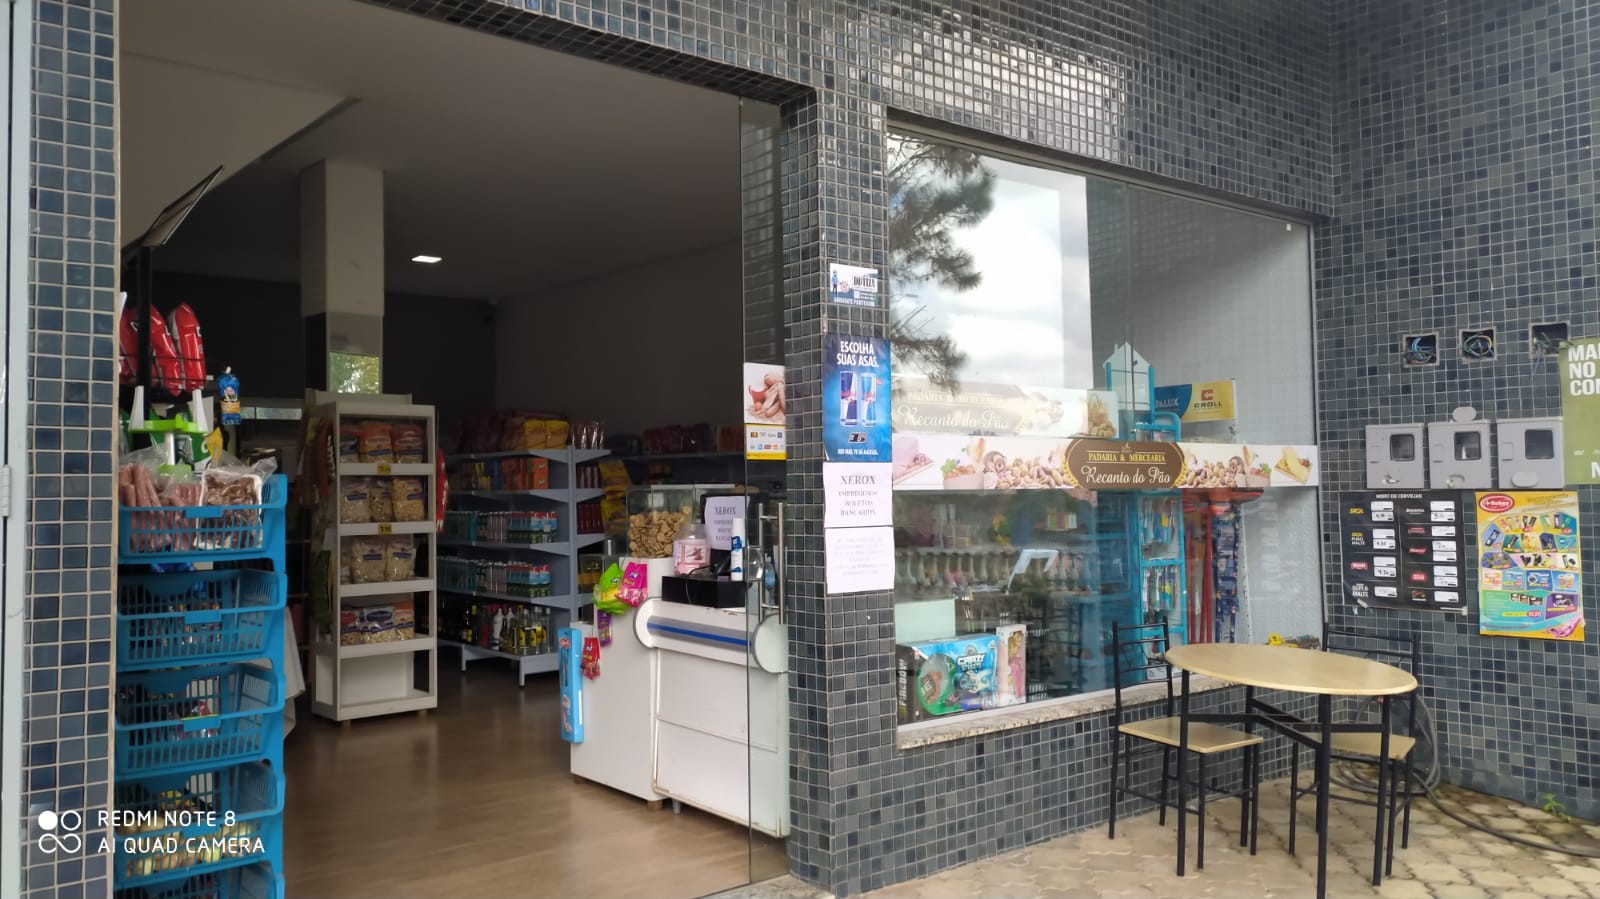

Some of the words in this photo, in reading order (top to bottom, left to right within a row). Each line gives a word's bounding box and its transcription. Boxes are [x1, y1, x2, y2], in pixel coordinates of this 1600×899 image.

[840, 341, 874, 355] ESCOLHA
[1568, 343, 1600, 361] MA
[836, 353, 857, 366] SUAS
[1569, 361, 1596, 379] NO
[1088, 452, 1117, 462] PADARIA
[1119, 453, 1126, 462] &
[1129, 453, 1165, 462] MERCEARIA
[840, 475, 876, 485] XEROX
[1080, 465, 1130, 484] Recanto
[1132, 467, 1146, 484] do
[1147, 466, 1170, 484] Pão
